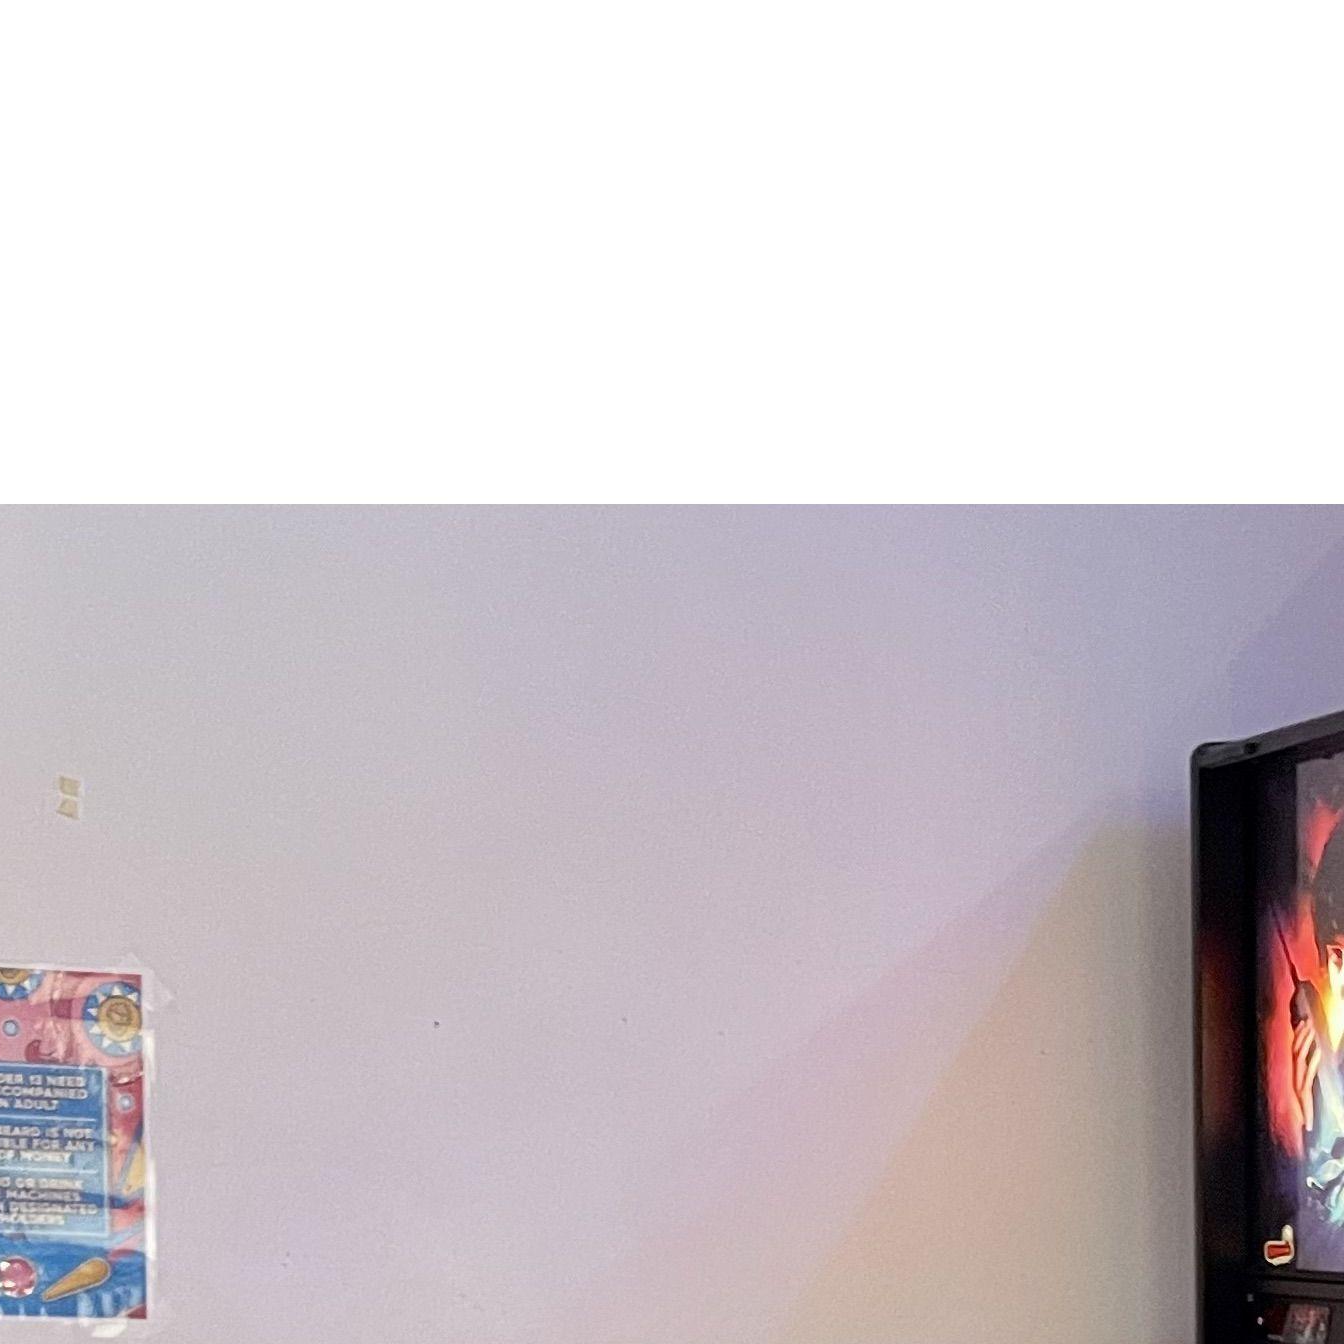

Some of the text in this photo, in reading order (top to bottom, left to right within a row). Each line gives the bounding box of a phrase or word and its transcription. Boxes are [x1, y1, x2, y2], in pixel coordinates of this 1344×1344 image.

[46, 1075, 87, 1088] NEED
[14, 1098, 59, 1111] ADULT
[45, 1127, 59, 1138] IS
[62, 1127, 95, 1140] NOT
[31, 1138, 60, 1150] FOR
[64, 1140, 96, 1152] ANY
[19, 1150, 73, 1163] MONEY
[14, 1177, 37, 1188] OR
[38, 1177, 85, 1190] DRINK
[9, 1201, 99, 1215] DESIGNATED
